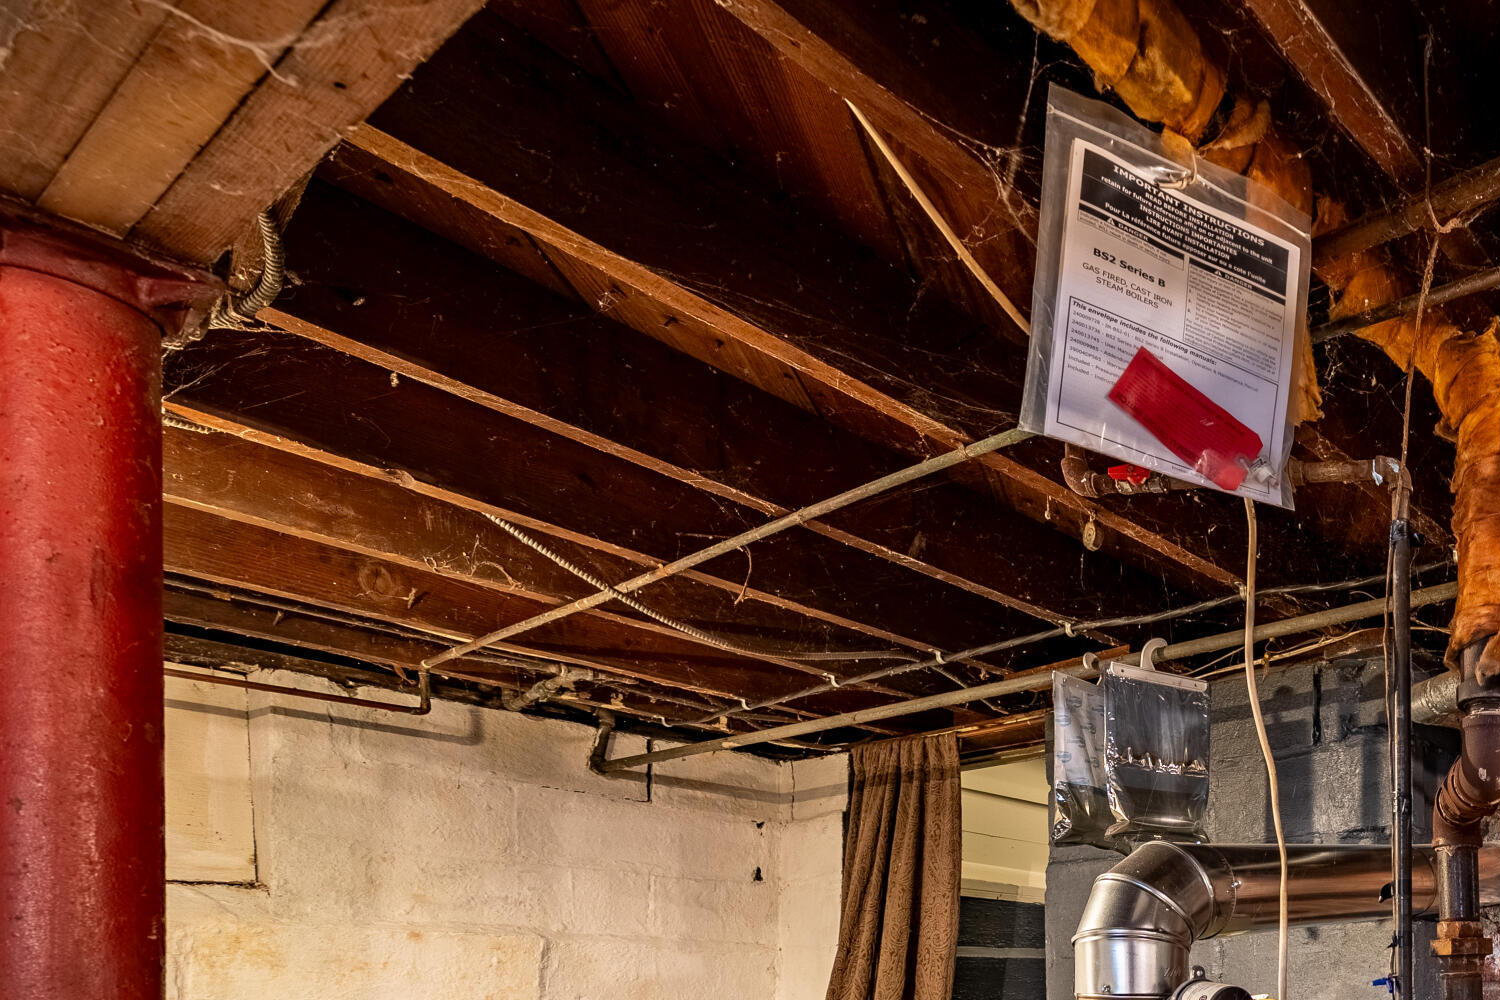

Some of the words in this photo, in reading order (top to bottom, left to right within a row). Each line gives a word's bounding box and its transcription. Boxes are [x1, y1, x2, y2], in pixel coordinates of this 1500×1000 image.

[1101, 175, 1120, 190] retain
[1122, 186, 1131, 196] for
[1132, 192, 1151, 207] future
[1215, 234, 1240, 250] adjacent
[1250, 249, 1259, 258] the
[1105, 202, 1120, 215] Pour
[1122, 211, 1129, 219] La
[1113, 164, 1180, 208] IMPORTANT
[1182, 203, 1264, 246] INSTRUCTIONS
[1145, 192, 1162, 205] READ
[1163, 202, 1187, 219] BEFORE
[1188, 215, 1233, 240] INSTALLATION
[1118, 222, 1148, 241] DANGER
[1139, 203, 1189, 234] INSTRUCTIONS
[1191, 230, 1237, 256] IMPORTANTES
[1146, 215, 1160, 228] LIRE
[1162, 224, 1182, 239] AVANT
[1184, 235, 1229, 260] INSTALLATION
[1082, 261, 1099, 275] GAS
[1102, 270, 1128, 288] FIRED,
[1130, 282, 1150, 297] CAST
[1153, 293, 1172, 307] IRON
[1093, 247, 1116, 265] BS2
[1119, 259, 1154, 283] Series
[1158, 278, 1165, 288] B
[1224, 273, 1252, 289] DANGER
[1095, 276, 1123, 293] STEAM
[1125, 288, 1158, 309] BOILERS
[1072, 300, 1086, 310] This
[1087, 307, 1118, 324] envelope
[1119, 319, 1145, 336] includes
[1147, 331, 1157, 340] the
[1159, 336, 1188, 354] following
[1190, 350, 1216, 365] manuals:
